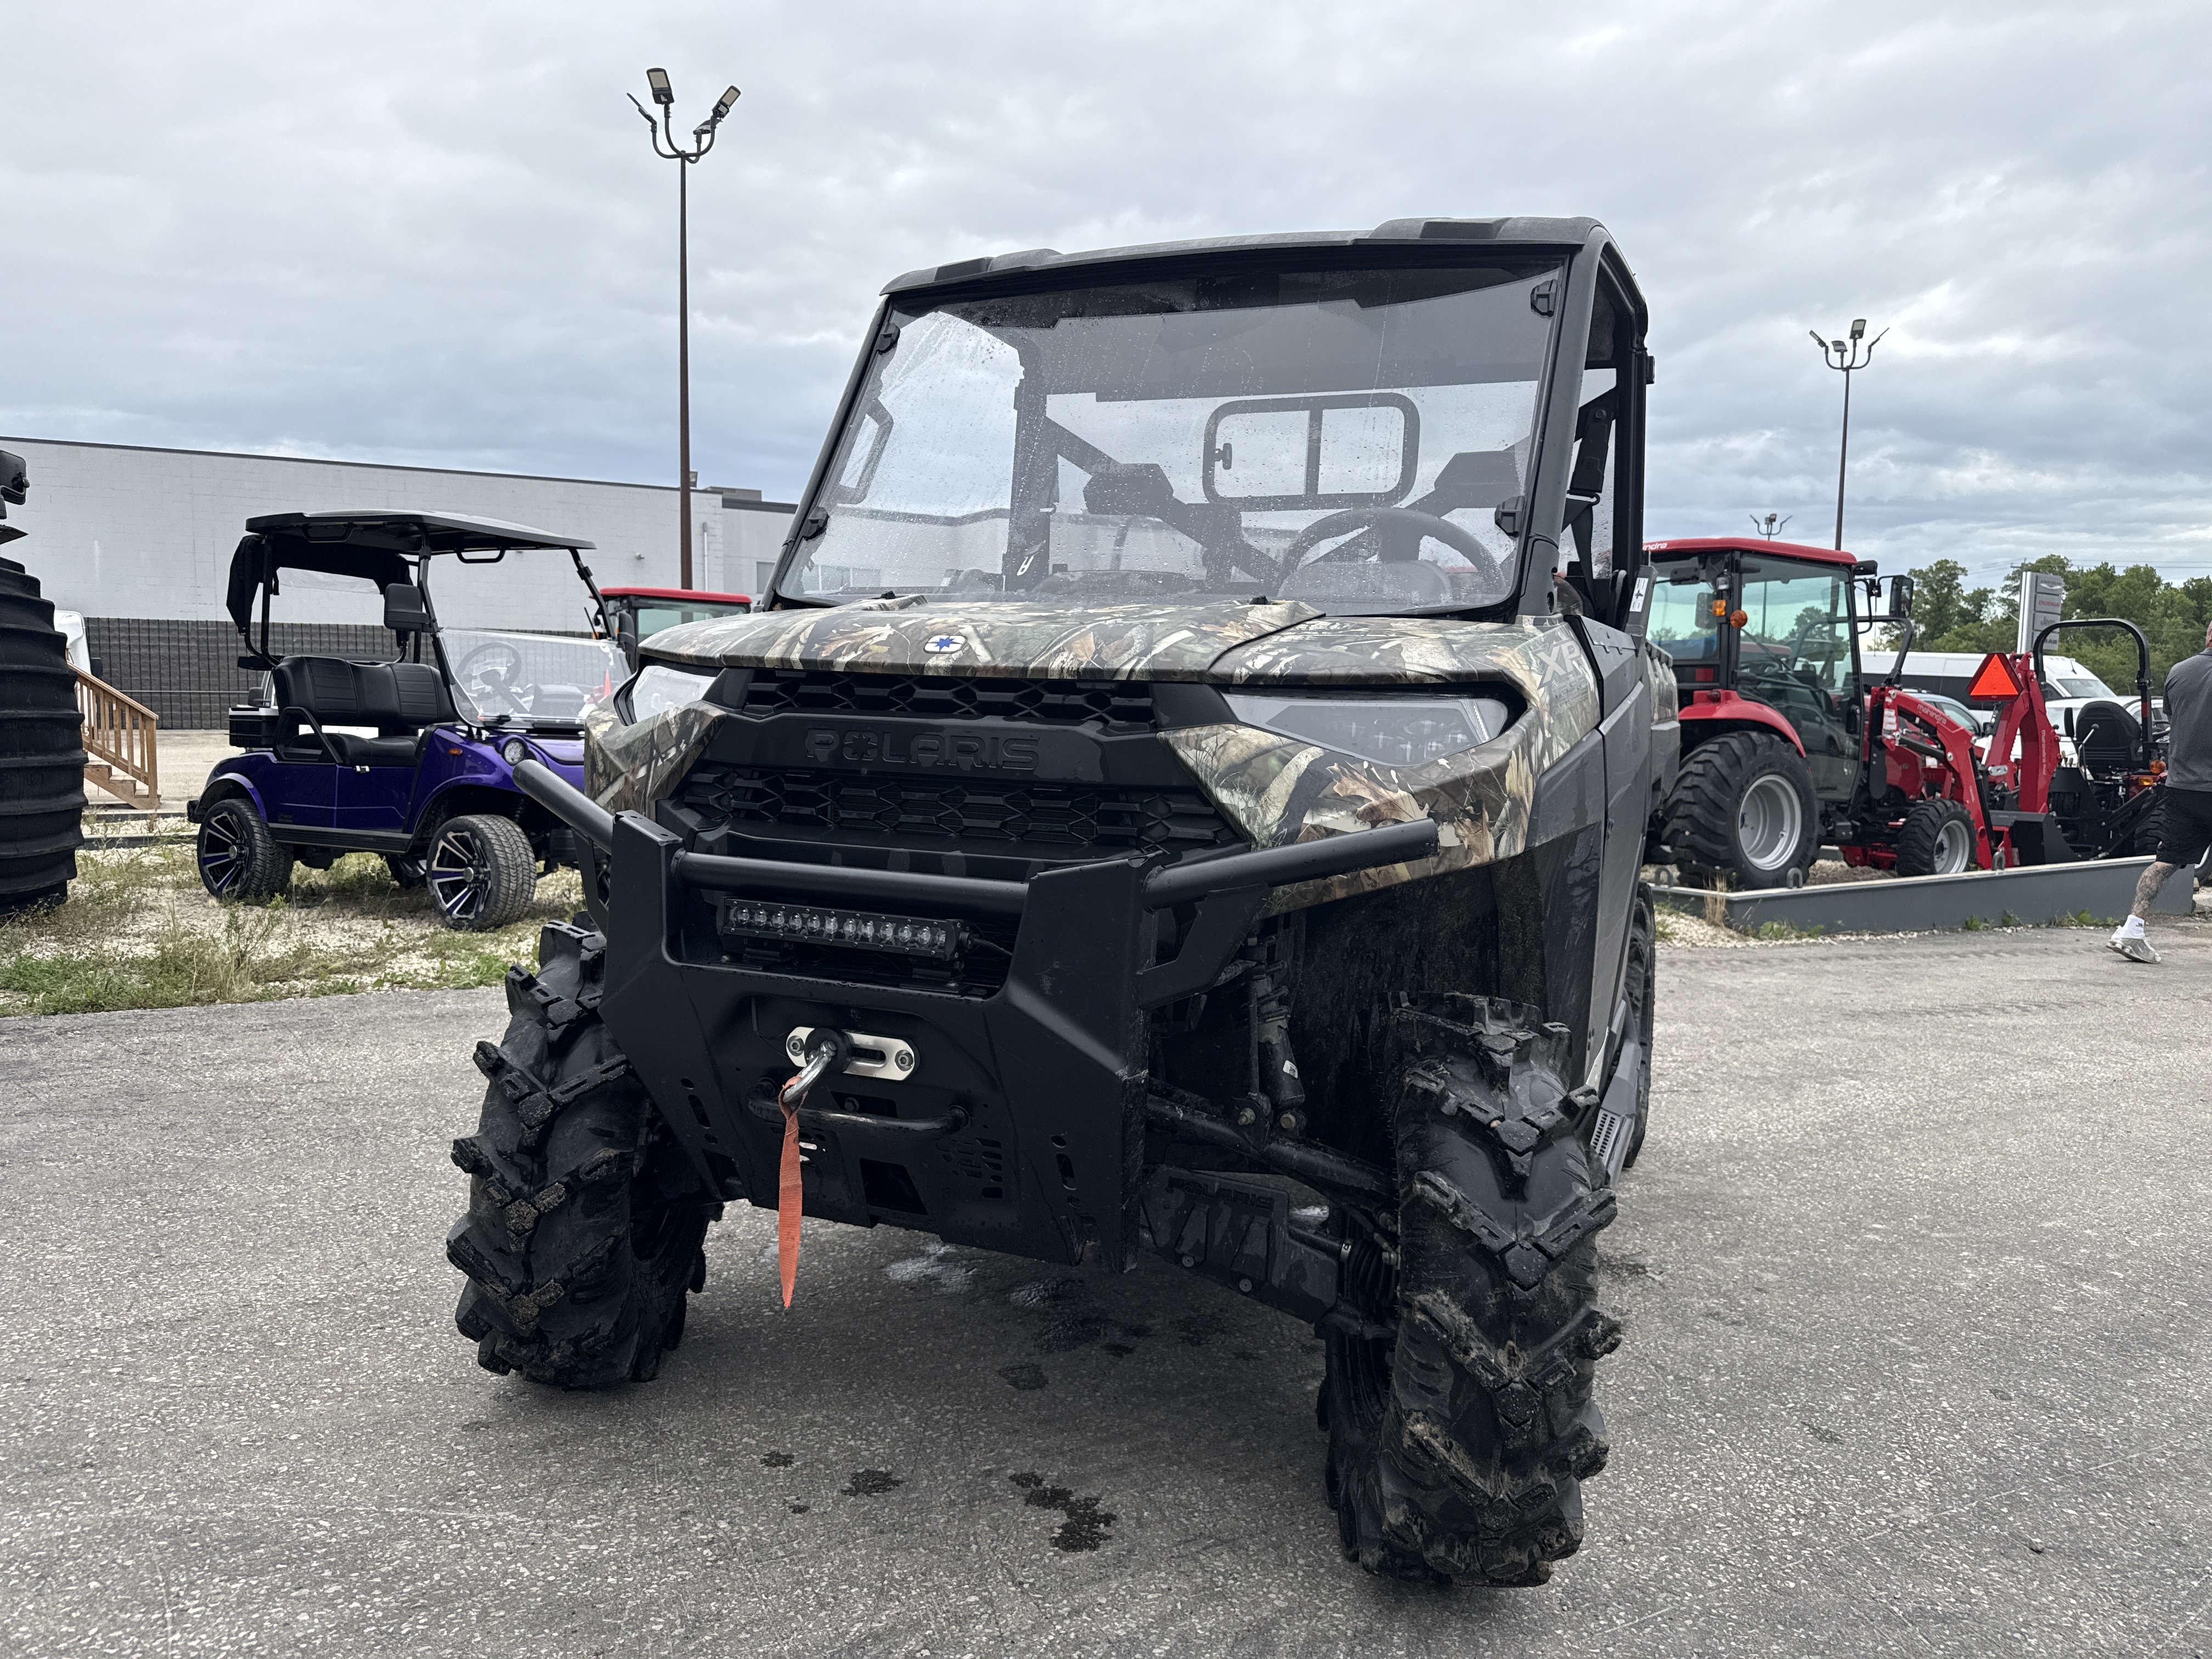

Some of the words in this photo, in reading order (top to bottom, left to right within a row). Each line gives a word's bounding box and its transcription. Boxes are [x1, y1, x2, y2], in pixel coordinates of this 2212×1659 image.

[1643, 543, 1668, 551] indra
[1536, 640, 1580, 685] XP
[1917, 703, 1946, 725] mahindra
[806, 727, 1040, 770] POLARIS
[1164, 1176, 1275, 1210] POLARIS
